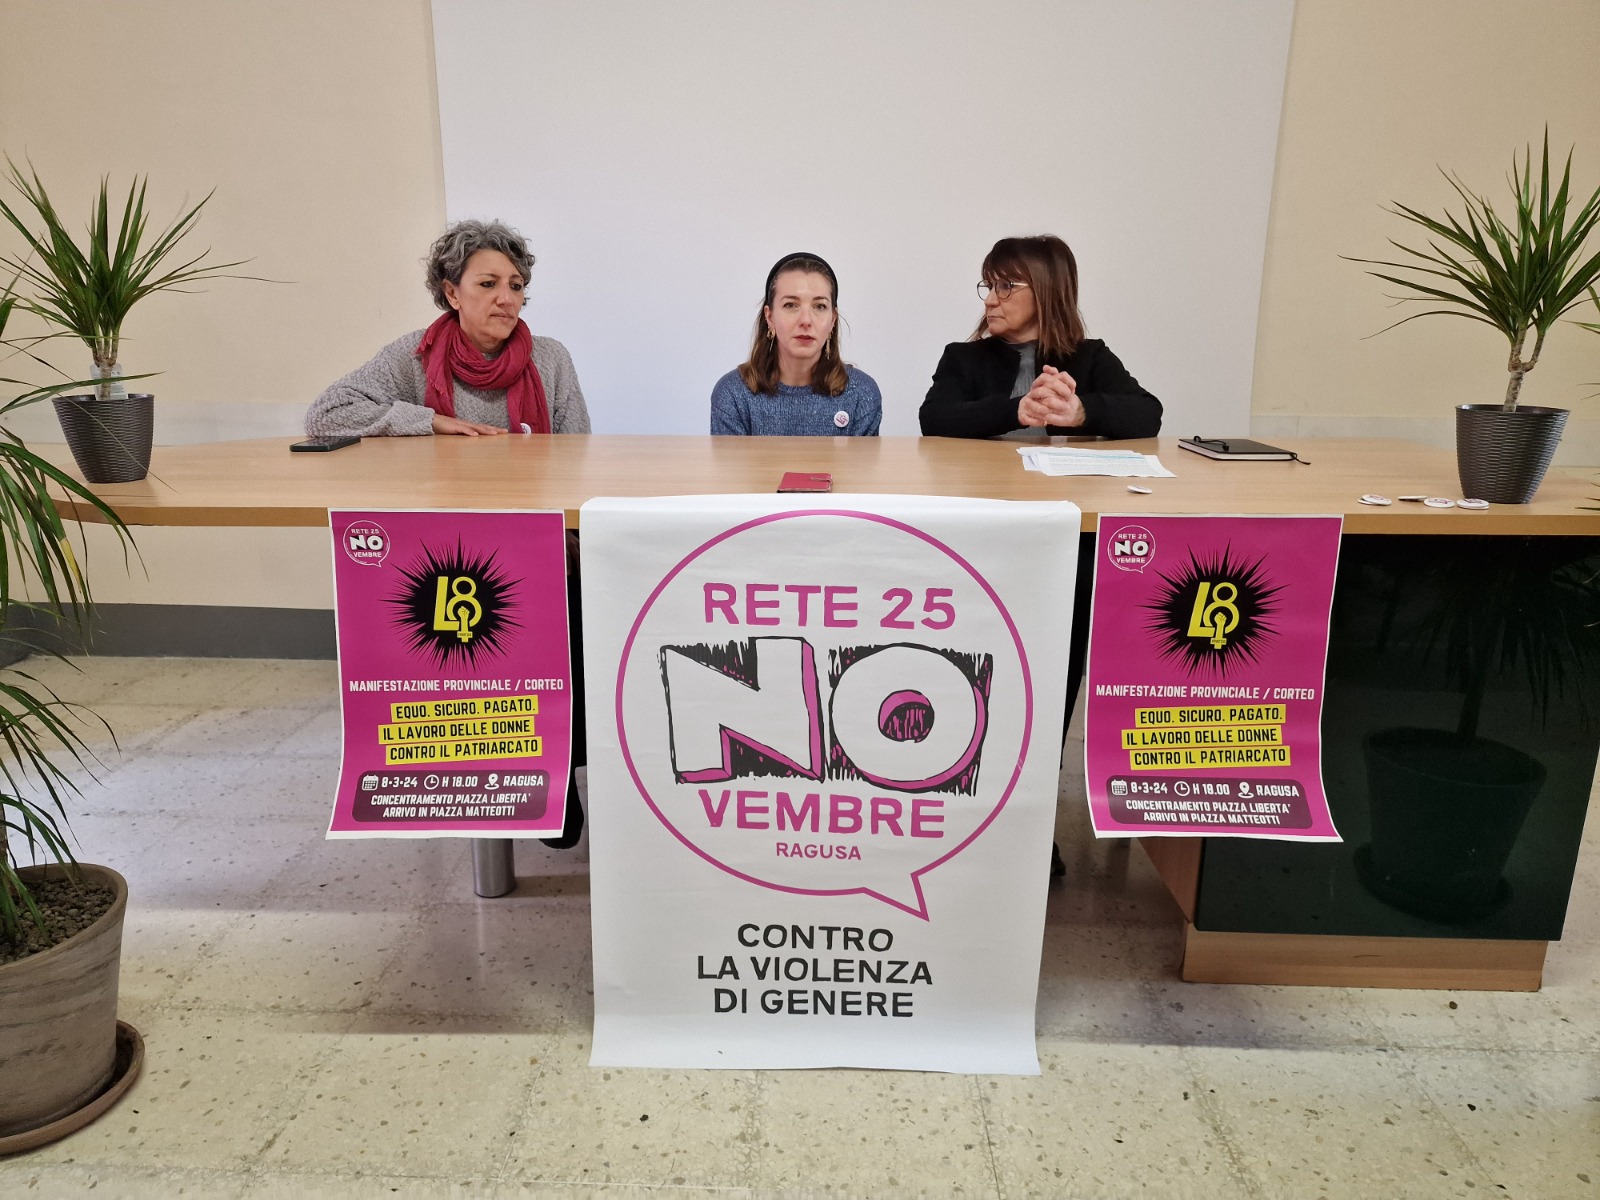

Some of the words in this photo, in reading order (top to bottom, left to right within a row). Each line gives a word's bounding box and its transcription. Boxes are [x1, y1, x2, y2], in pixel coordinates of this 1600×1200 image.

[350, 534, 384, 551] NO
[1114, 540, 1149, 556] NO
[703, 582, 858, 628] RETE
[879, 587, 956, 631] 25
[349, 679, 440, 692] MANIFESTAZIONE
[443, 679, 511, 692] PROVINCIALE
[524, 678, 564, 691] CORTEO
[1096, 684, 1187, 698] MANIFESTAZIONE
[1190, 685, 1260, 699] PROVINCIALE
[1273, 687, 1315, 700] CORTEO
[396, 705, 430, 720] EQUO.
[434, 702, 480, 717] SICURO.
[484, 698, 536, 714] PAGATO.
[657, 635, 994, 798] NO
[1140, 711, 1174, 725] EQUO.
[1179, 708, 1225, 723] SICURO.
[1229, 707, 1283, 721] PAGATO.
[383, 728, 394, 741] IL
[398, 724, 446, 741] LAVORO
[450, 722, 488, 738] DELLE
[492, 719, 531, 735] DONNE
[1126, 732, 1138, 746] IL
[1142, 730, 1191, 745] LAVORO
[1195, 729, 1233, 744] DELLE
[1238, 727, 1278, 743] DONNE
[390, 745, 436, 761] CONTRO
[440, 744, 450, 757] IL
[455, 739, 538, 757] PATRIARCATO
[1134, 751, 1181, 766] CONTRO
[1185, 751, 1196, 764] IL
[1200, 748, 1286, 764] PATRIARCATO
[442, 776, 449, 788] H
[452, 775, 479, 788] 18.00
[502, 775, 544, 787] RAGUSA
[1192, 783, 1200, 795] H
[1202, 783, 1230, 795] 18.00
[1255, 784, 1300, 797] RAGUSA
[370, 794, 453, 806] CONCENTRAMENTO
[455, 793, 488, 805] PIAZZA
[1126, 800, 1211, 812] CONCENTRAMENTO
[1212, 801, 1248, 813] PIAZZA
[382, 806, 417, 818] ARRIVO
[418, 806, 428, 818] IN
[429, 806, 463, 817] PIAZZA
[465, 805, 515, 817] MATTEOTTI
[698, 789, 945, 839] VEMBRE
[1143, 812, 1178, 822] ARRIVO
[1179, 812, 1190, 822] IN
[1191, 813, 1227, 824] PIAZZA
[1227, 814, 1281, 825] MATTEOTTI
[775, 842, 862, 861] RAGUSA
[737, 923, 894, 952] CONTRO
[697, 955, 740, 981] LA
[750, 956, 933, 985] VIOLENZA
[713, 988, 747, 1015] DI
[760, 988, 914, 1018] GENERE
